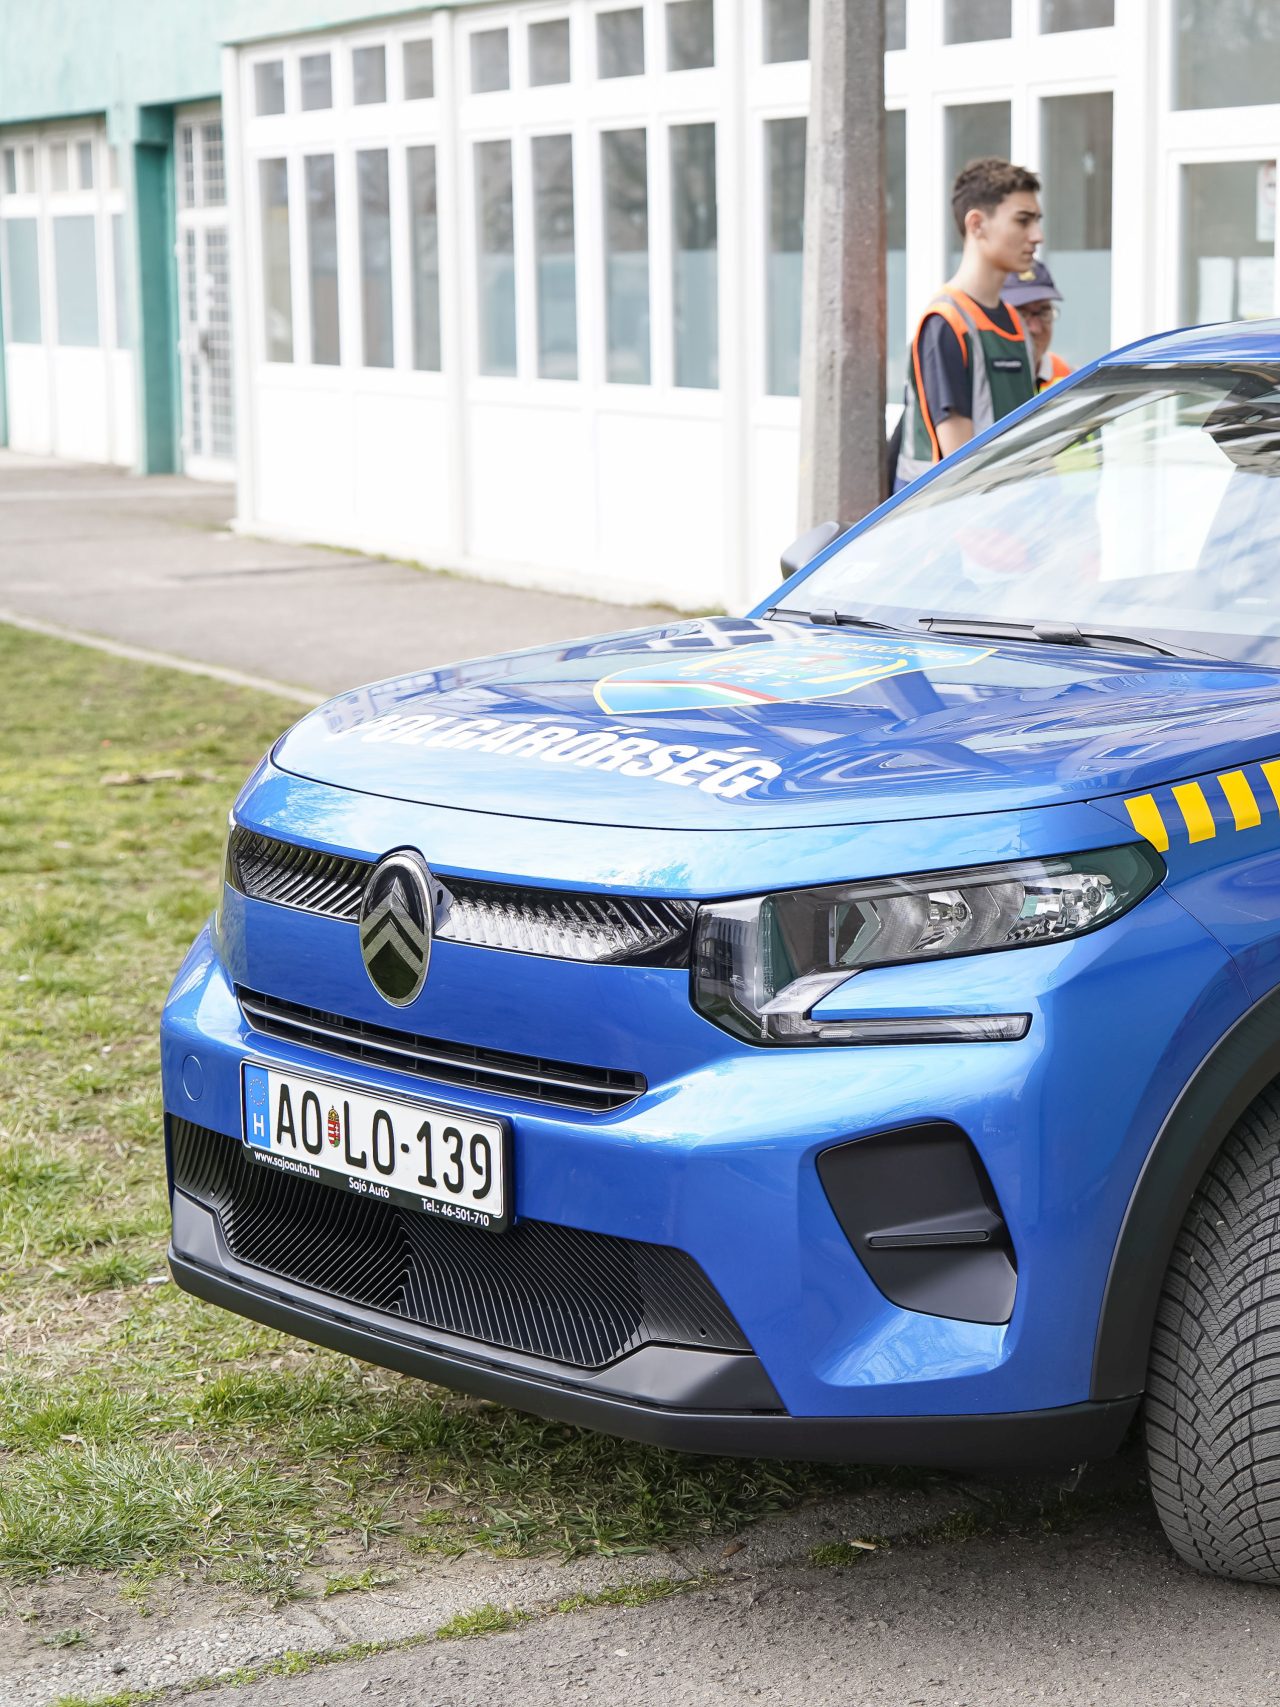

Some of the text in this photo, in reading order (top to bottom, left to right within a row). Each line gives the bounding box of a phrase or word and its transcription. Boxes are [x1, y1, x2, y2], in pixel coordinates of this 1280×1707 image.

[322, 714, 783, 800] POLGÁRŐRSÉG
[253, 1112, 265, 1138] H
[254, 1151, 320, 1179] www.sajoauto.hu
[348, 1176, 390, 1199] Sajó Autó
[421, 1197, 490, 1227] Tel.: 46-501-710
